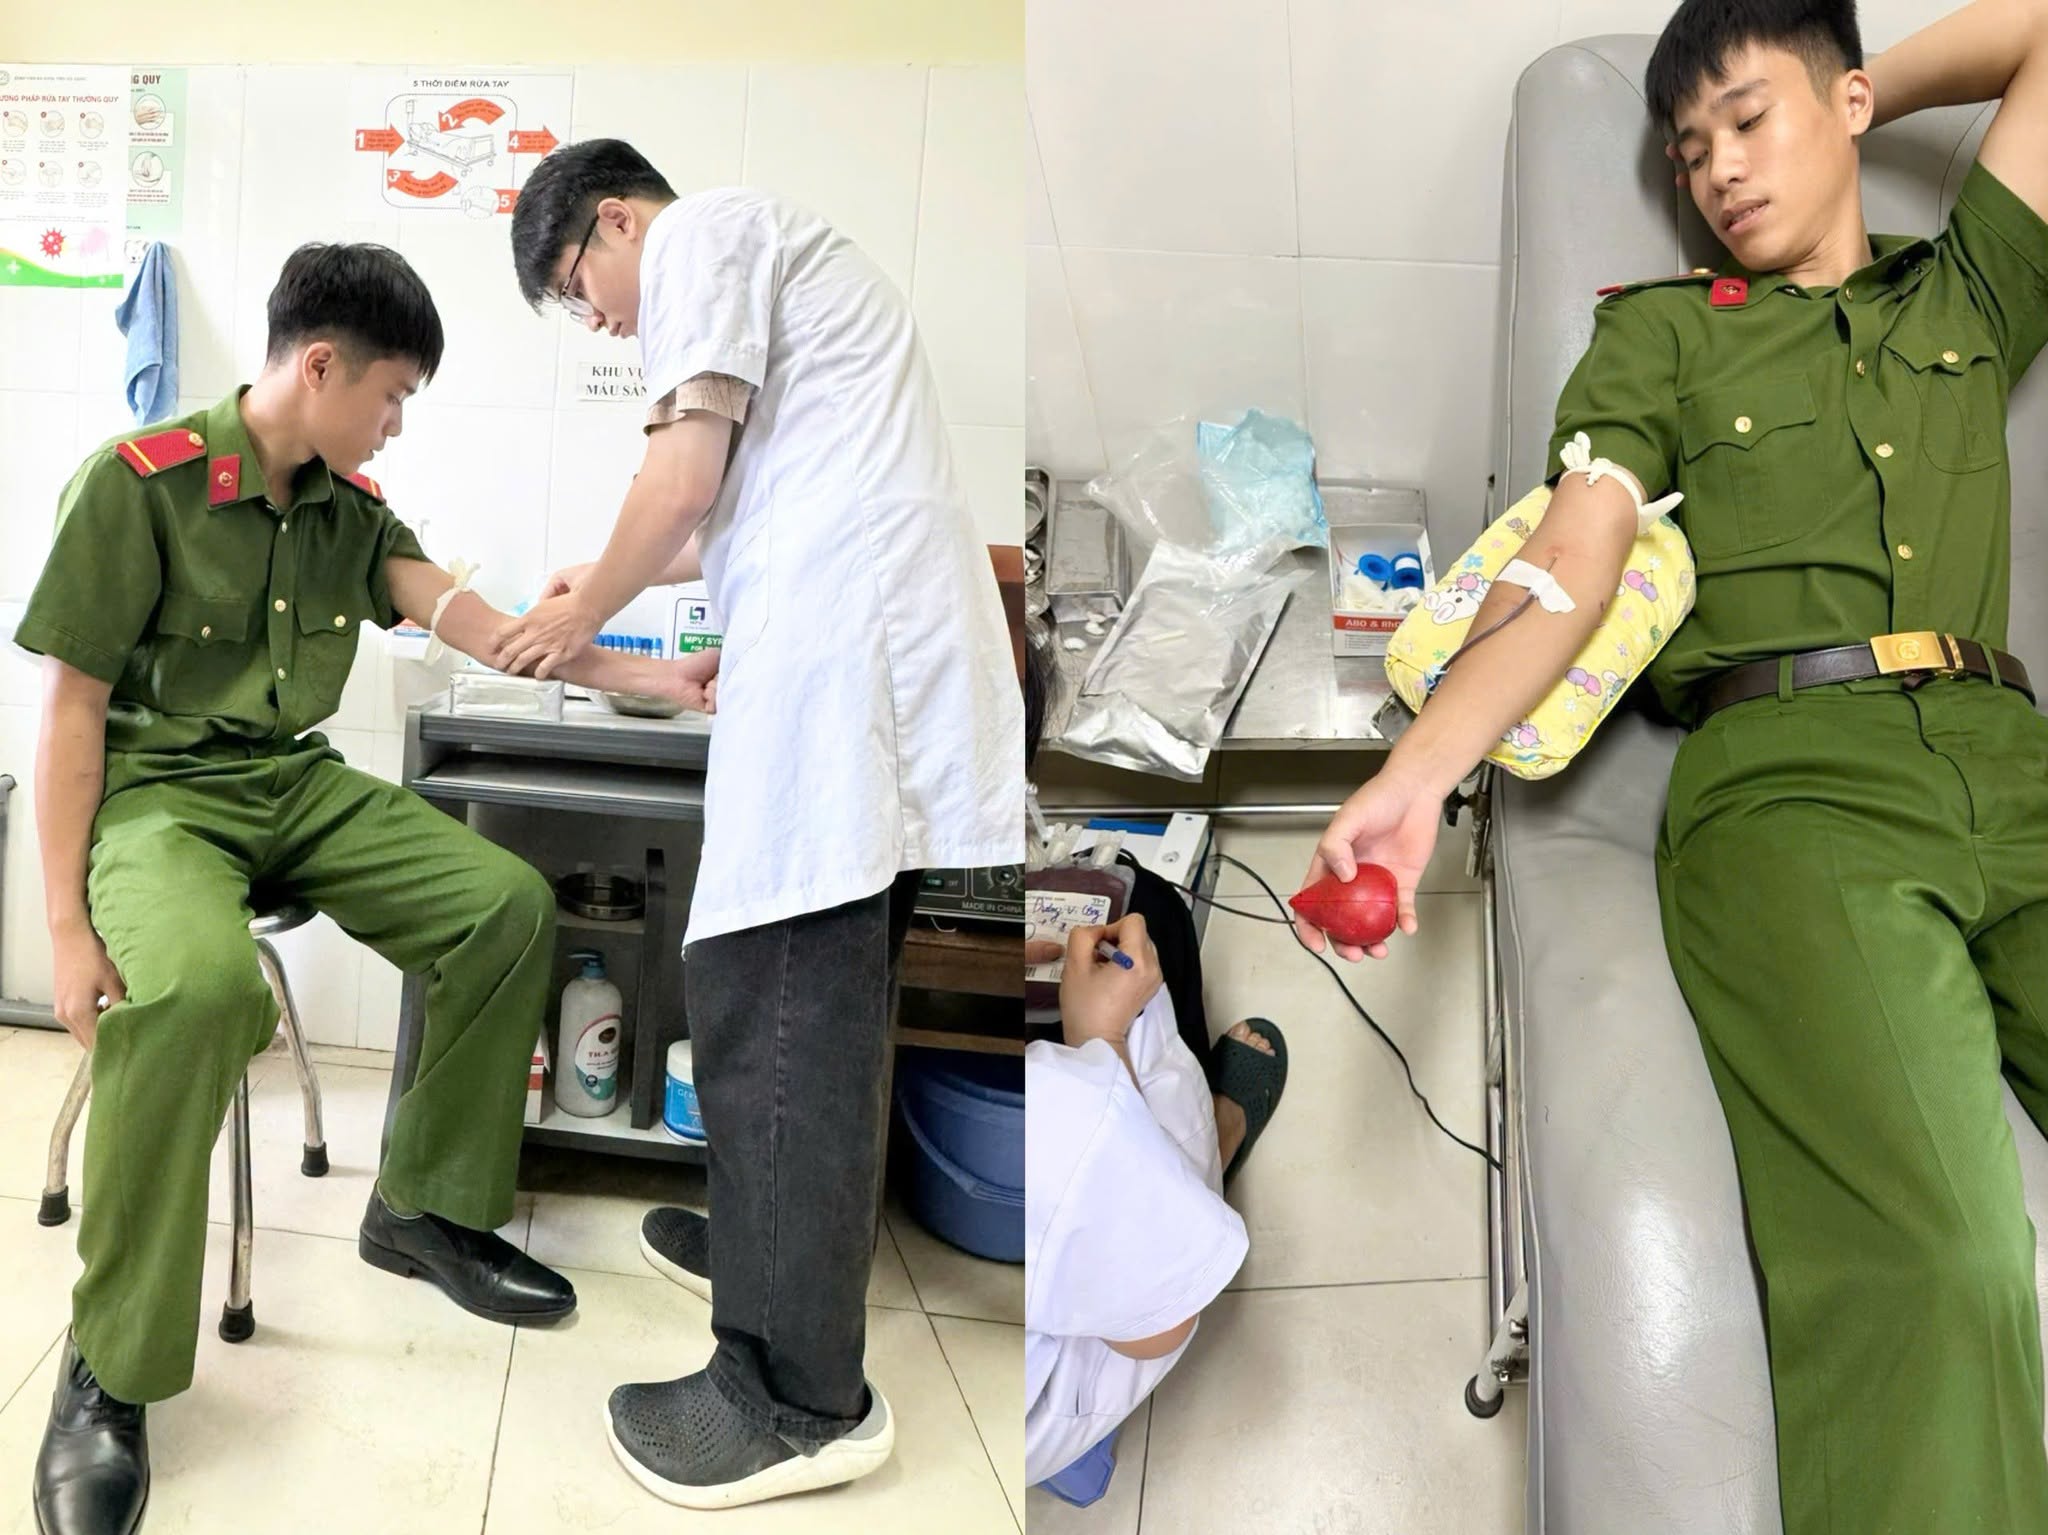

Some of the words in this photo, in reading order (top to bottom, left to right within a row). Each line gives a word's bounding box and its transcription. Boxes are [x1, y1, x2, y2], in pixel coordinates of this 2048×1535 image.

[142, 74, 161, 85] QUY
[413, 80, 419, 88] 5
[492, 80, 510, 88] TAY
[58, 95, 71, 103] TAY
[442, 113, 459, 128] 2
[356, 132, 364, 149] 1
[509, 134, 520, 149] 4
[388, 170, 401, 183] 3
[500, 194, 511, 207] 5
[592, 366, 623, 378] KHU
[1345, 618, 1367, 627] ABO
[684, 635, 705, 645] MPV
[962, 901, 985, 911] MADE
[986, 902, 996, 912] IN
[997, 904, 1024, 914] CHINA
